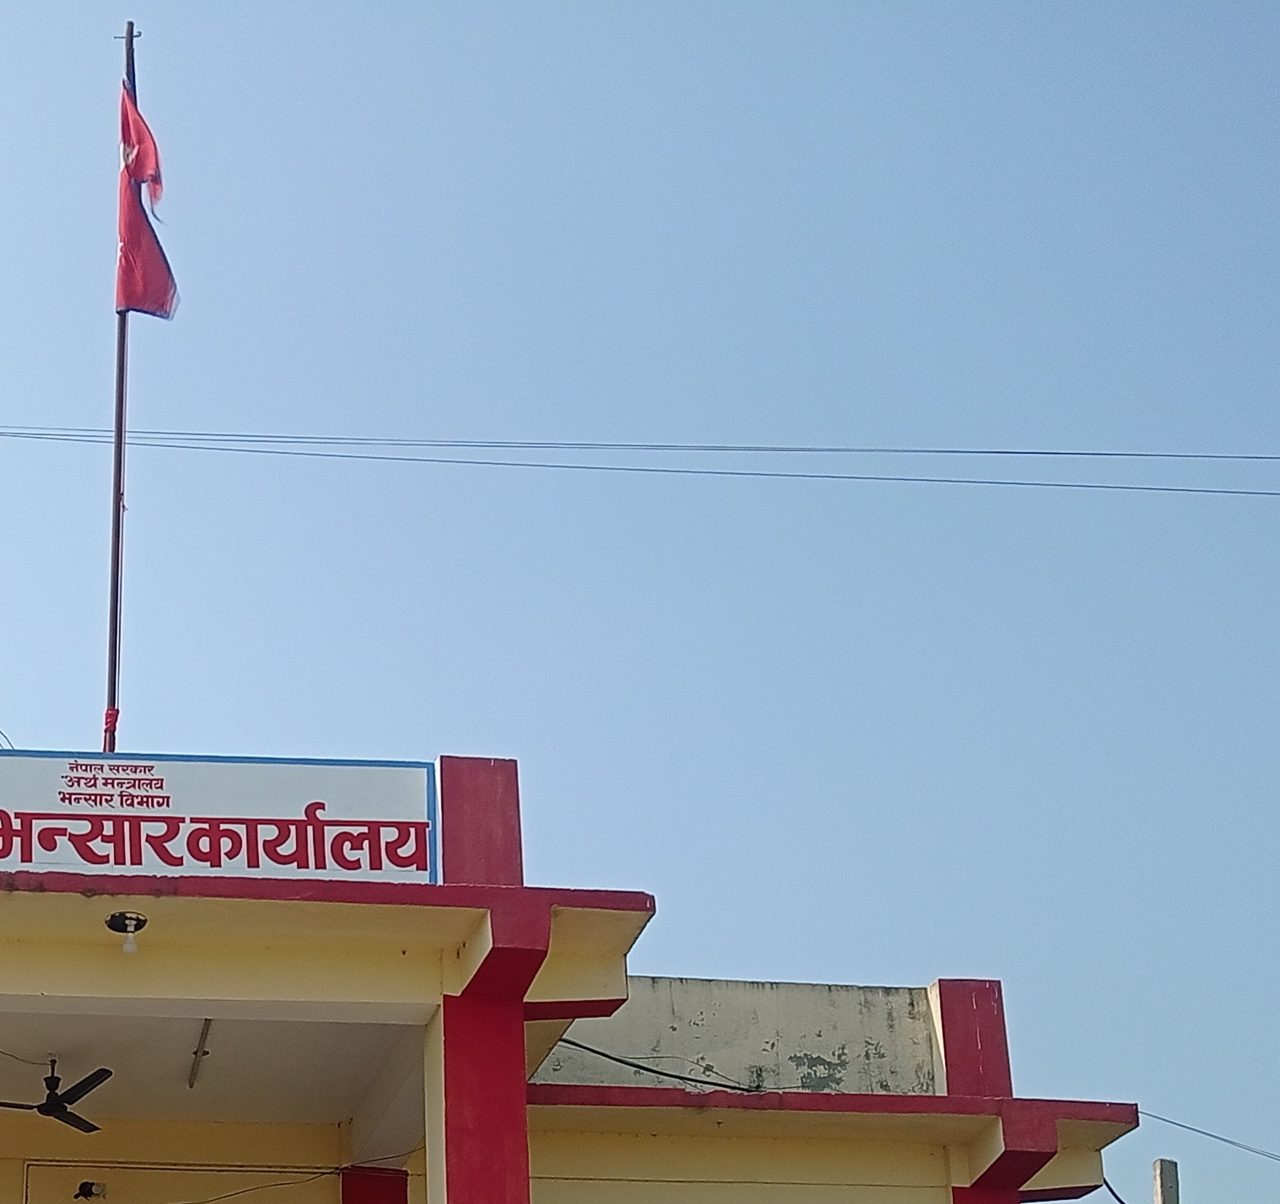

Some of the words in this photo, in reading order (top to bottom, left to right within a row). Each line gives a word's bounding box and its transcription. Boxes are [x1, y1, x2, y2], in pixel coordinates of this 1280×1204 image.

[68, 760, 104, 774] नेपाल
[107, 764, 154, 776] सरकार
[64, 774, 98, 789] अर्थ
[101, 777, 164, 792] मन्त्रालय
[58, 791, 115, 808] भन्सार
[117, 791, 171, 808] विभाग
[186, 802, 430, 872] कार्यालय
